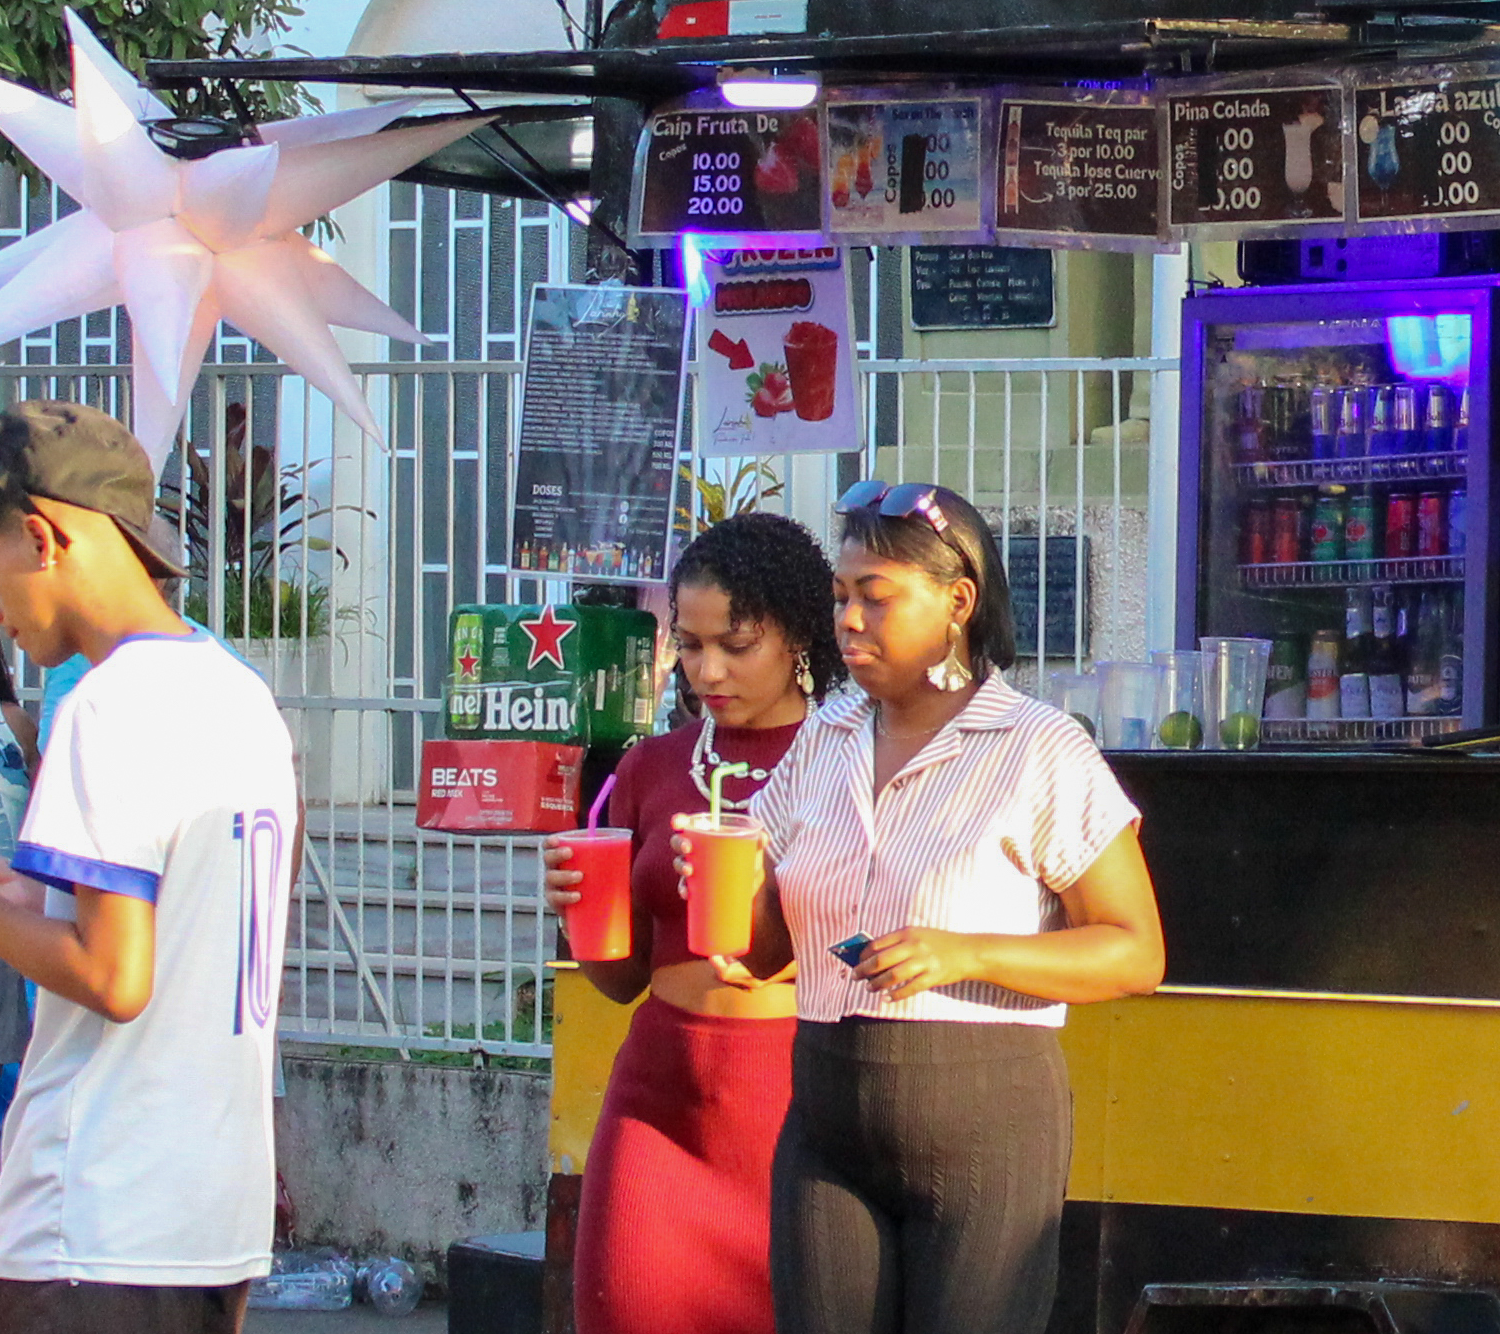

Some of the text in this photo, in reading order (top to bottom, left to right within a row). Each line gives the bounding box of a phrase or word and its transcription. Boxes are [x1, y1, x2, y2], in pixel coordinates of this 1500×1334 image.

[1213, 98, 1271, 119] Colada
[652, 113, 779, 141] Caip Fruta De
[1045, 121, 1093, 142] Tequila
[1057, 142, 1067, 156] 3
[1070, 146, 1093, 162] por
[1055, 181, 1066, 196] 3
[1068, 185, 1092, 200] por
[532, 483, 563, 496] DOSES
[431, 767, 498, 787] BEATS
[232, 807, 285, 1037] 10
